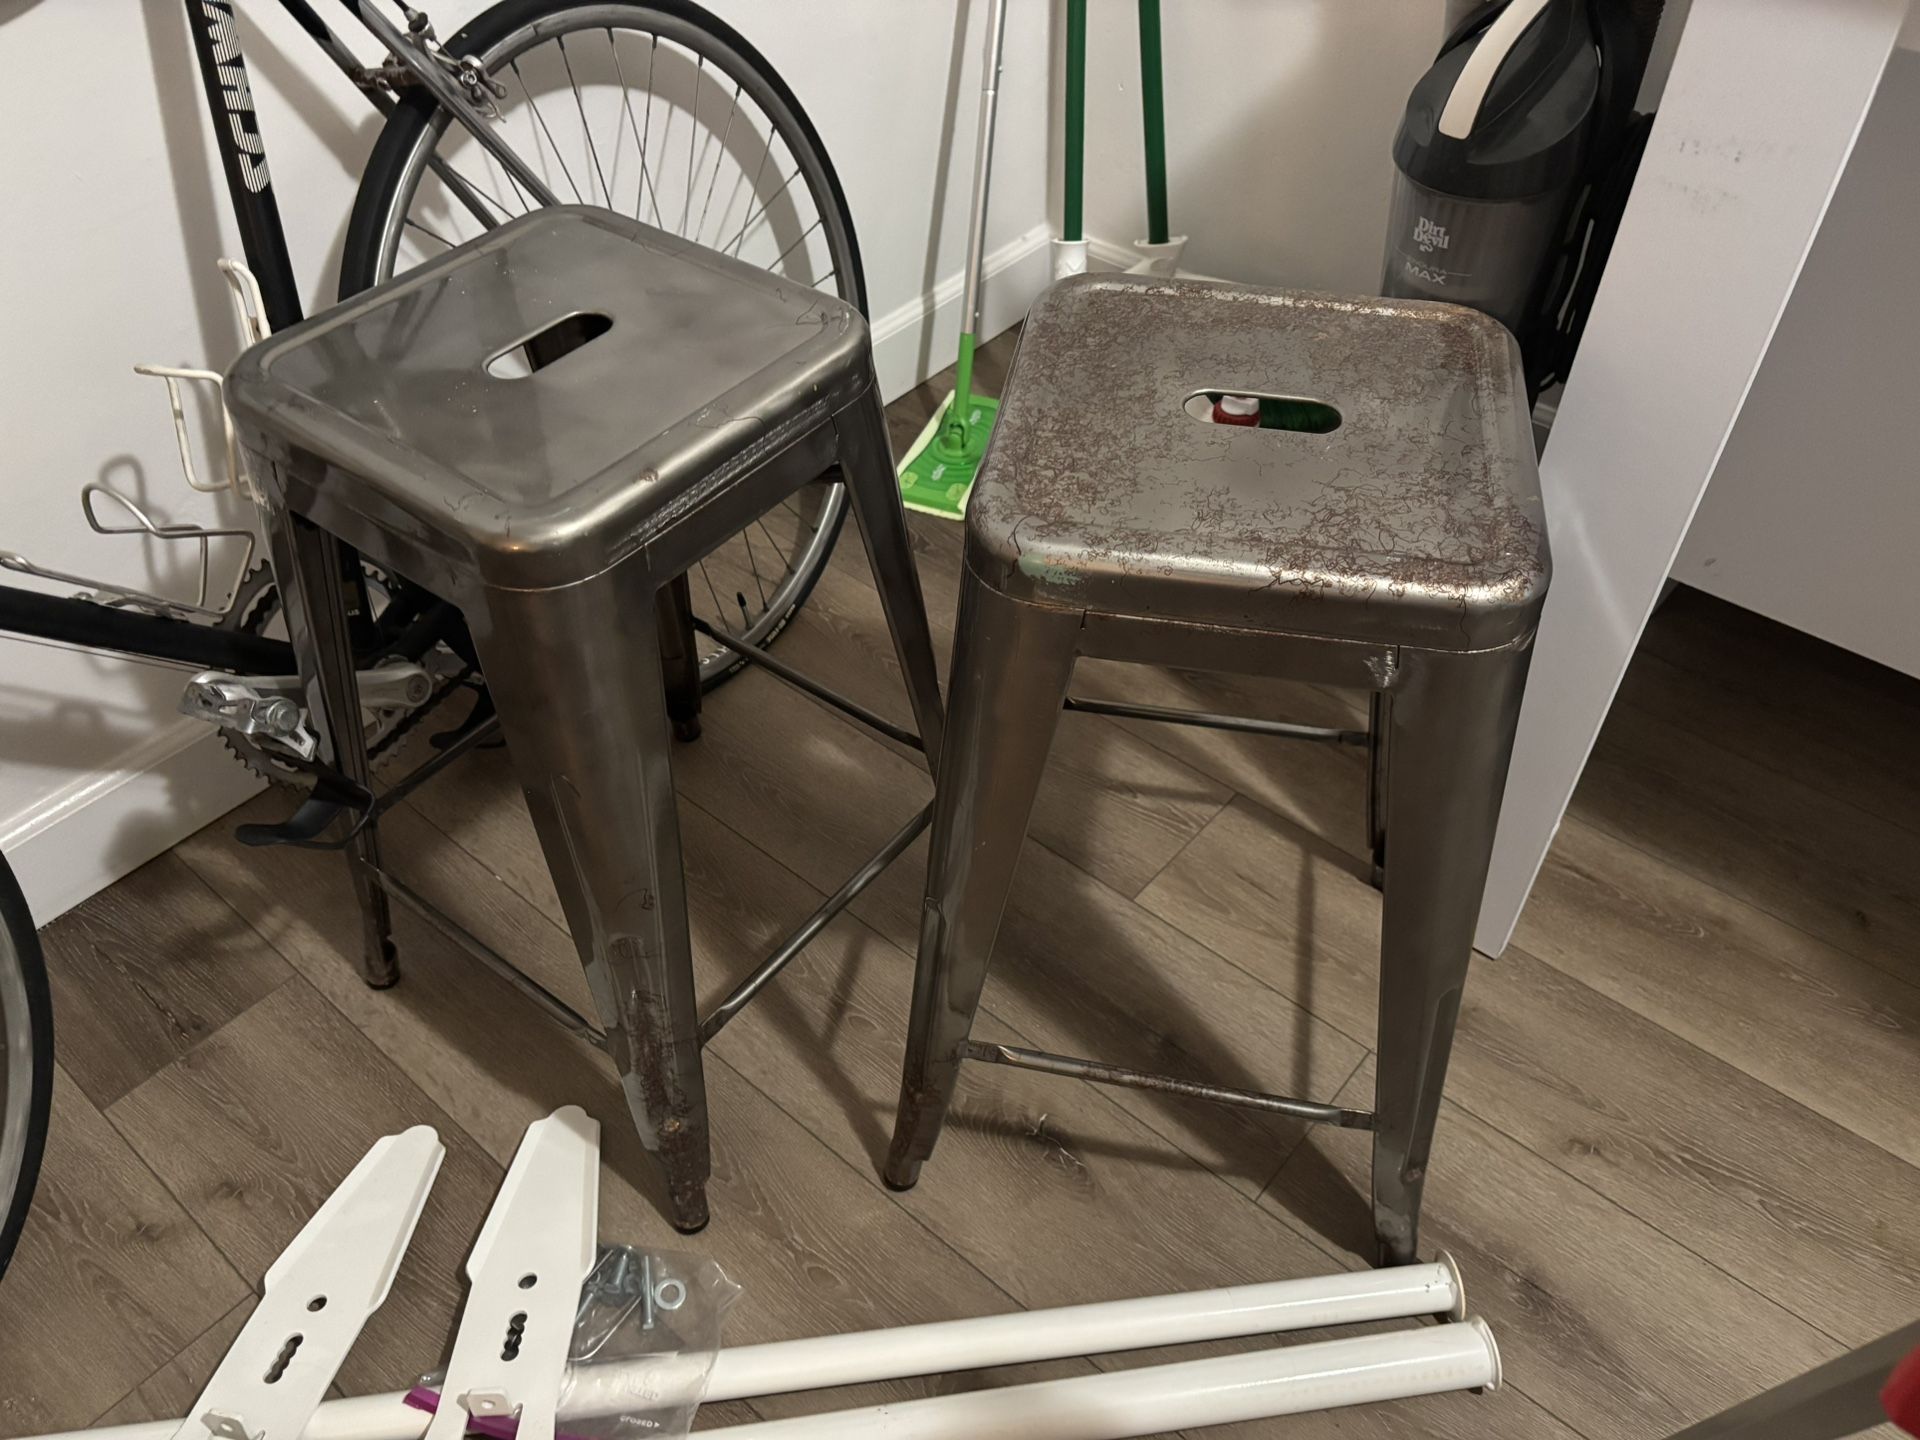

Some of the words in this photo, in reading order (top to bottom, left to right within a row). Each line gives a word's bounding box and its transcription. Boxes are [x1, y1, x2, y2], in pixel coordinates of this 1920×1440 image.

[200, 0, 271, 194] SCHW
[1418, 216, 1446, 236] Dirt
[1413, 227, 1450, 249] Devil
[1405, 261, 1446, 286] MAX
